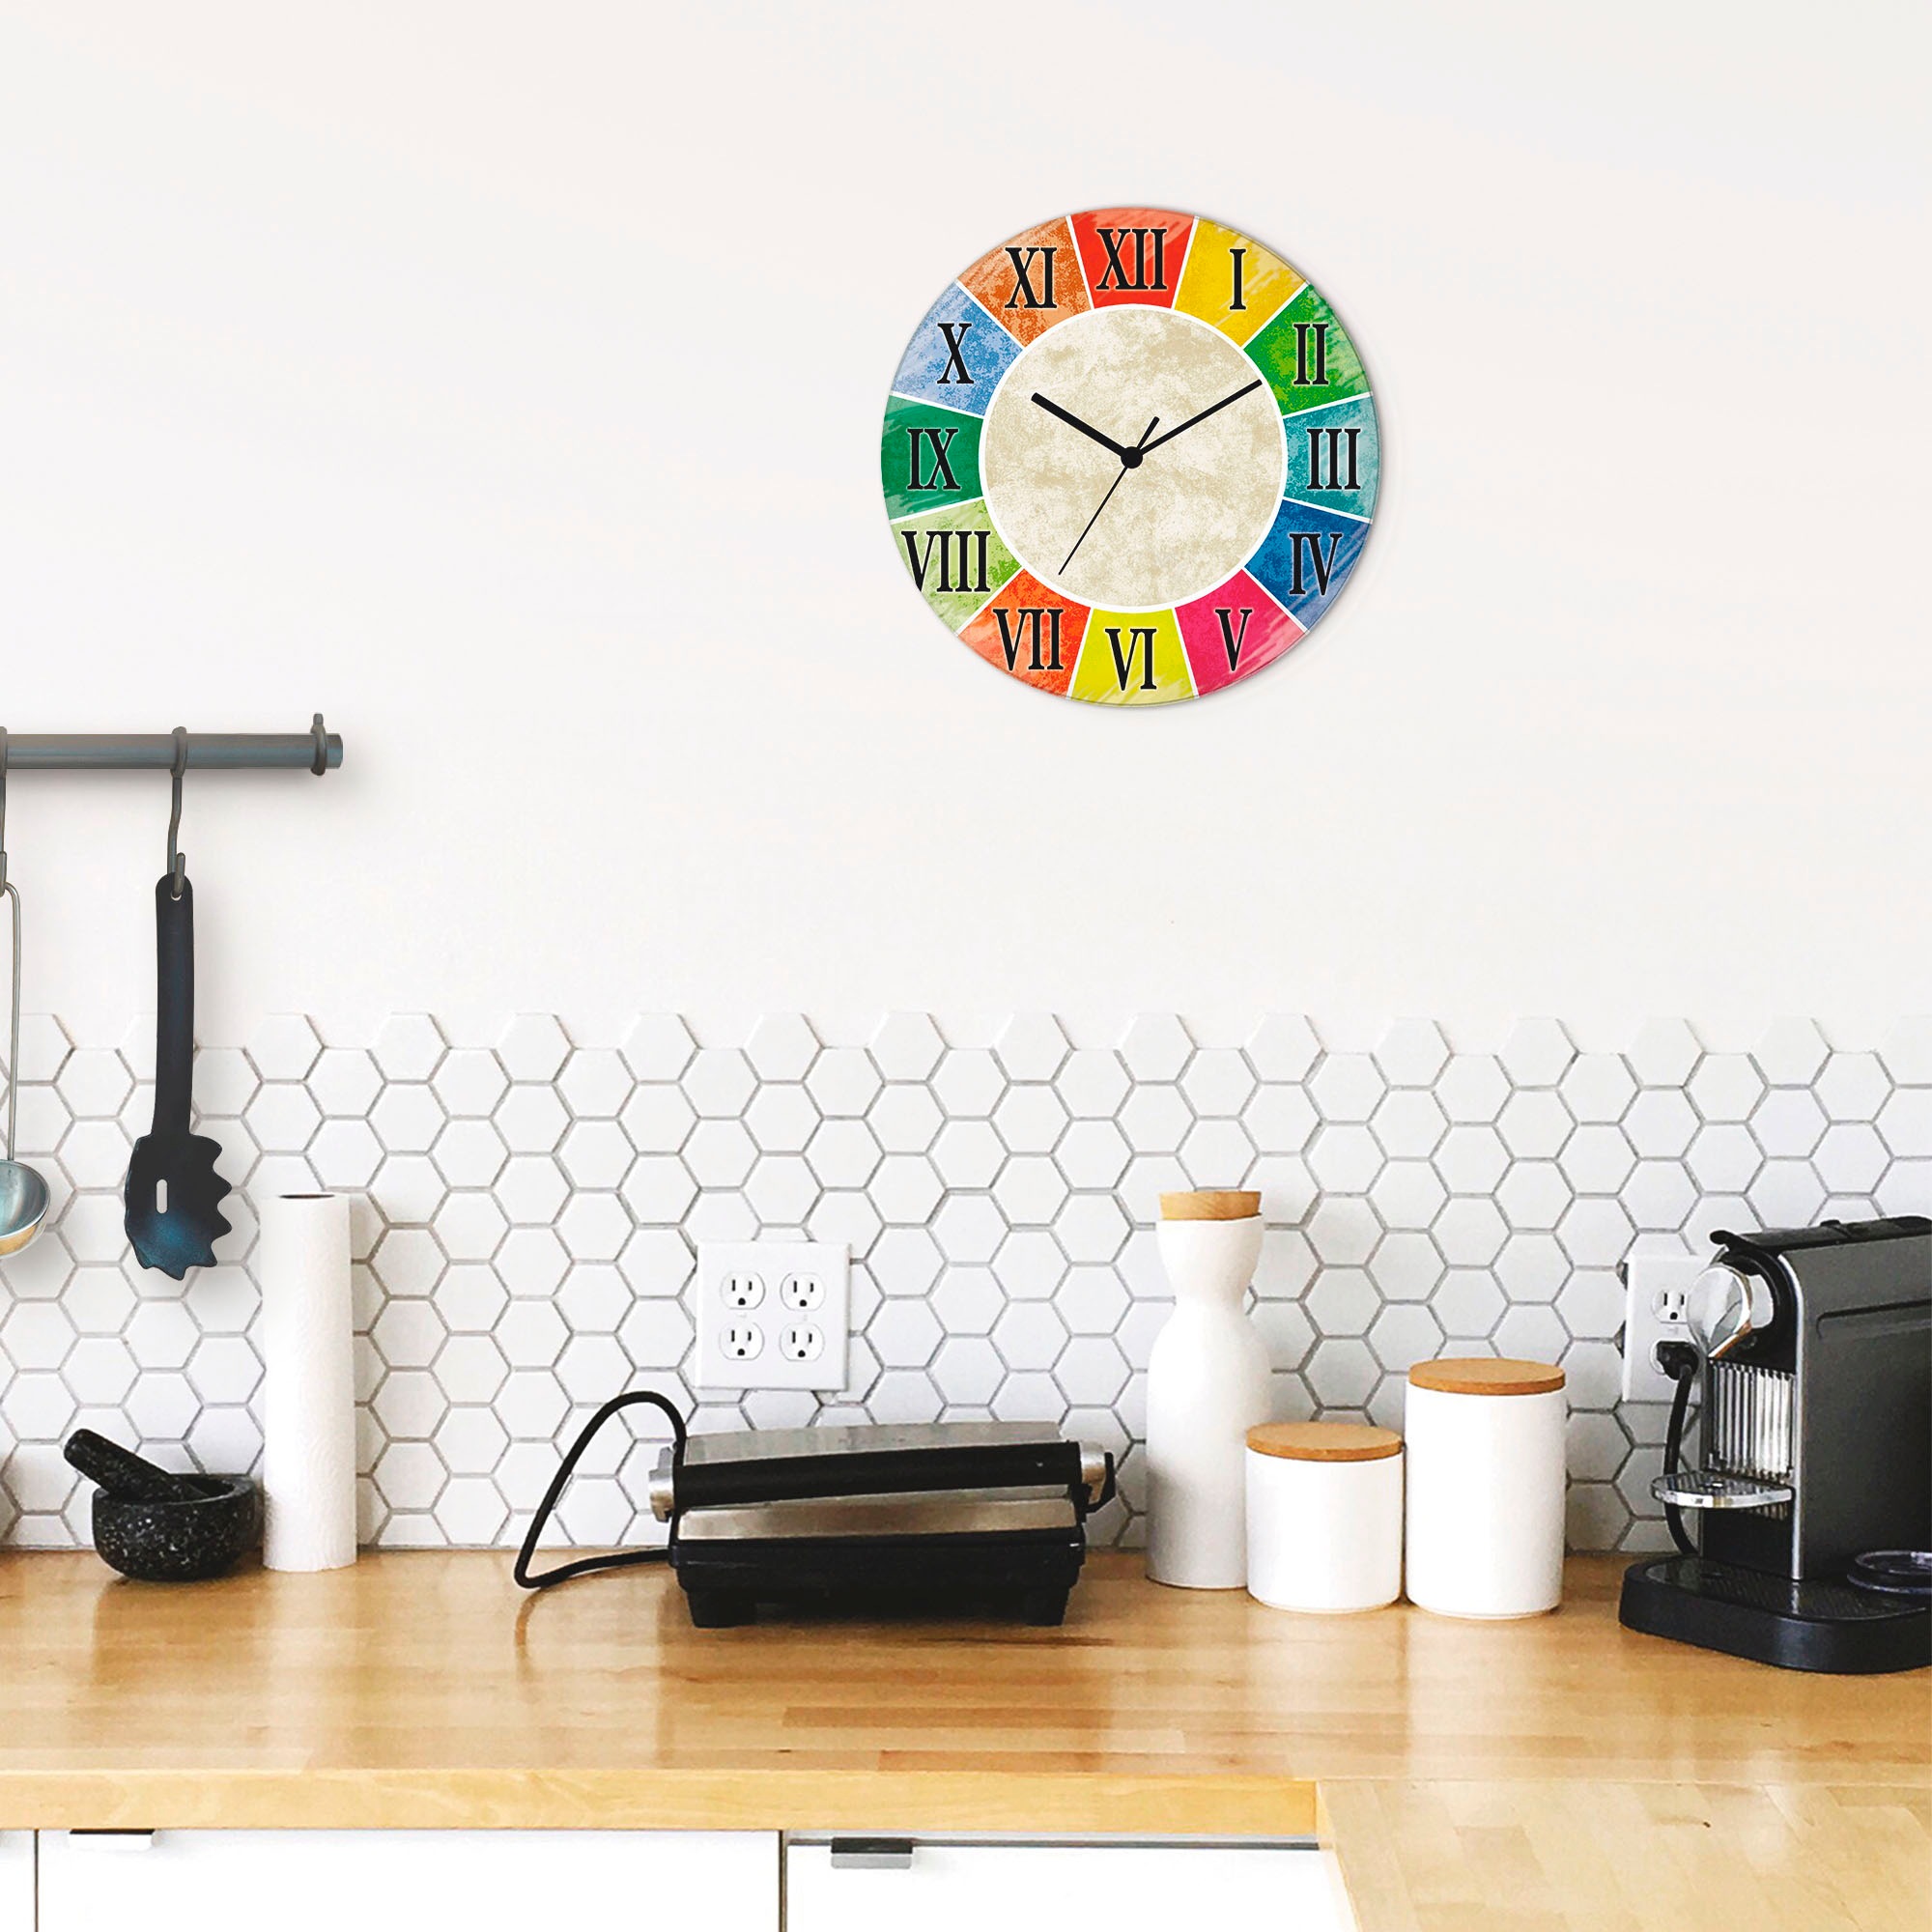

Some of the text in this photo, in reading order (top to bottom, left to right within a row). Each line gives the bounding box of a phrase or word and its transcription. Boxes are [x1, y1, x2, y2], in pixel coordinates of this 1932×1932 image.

[1005, 247, 1058, 309] XI
[1096, 228, 1167, 290] XII
[1230, 248, 1246, 310] I
[937, 323, 974, 384] X
[1293, 324, 1329, 385] II
[907, 428, 960, 490] IX
[1307, 428, 1361, 490] III
[901, 530, 991, 592] VIII
[1290, 533, 1343, 596] IV
[993, 609, 1064, 670] VII
[1105, 628, 1157, 692] VI
[1215, 609, 1253, 671] V
